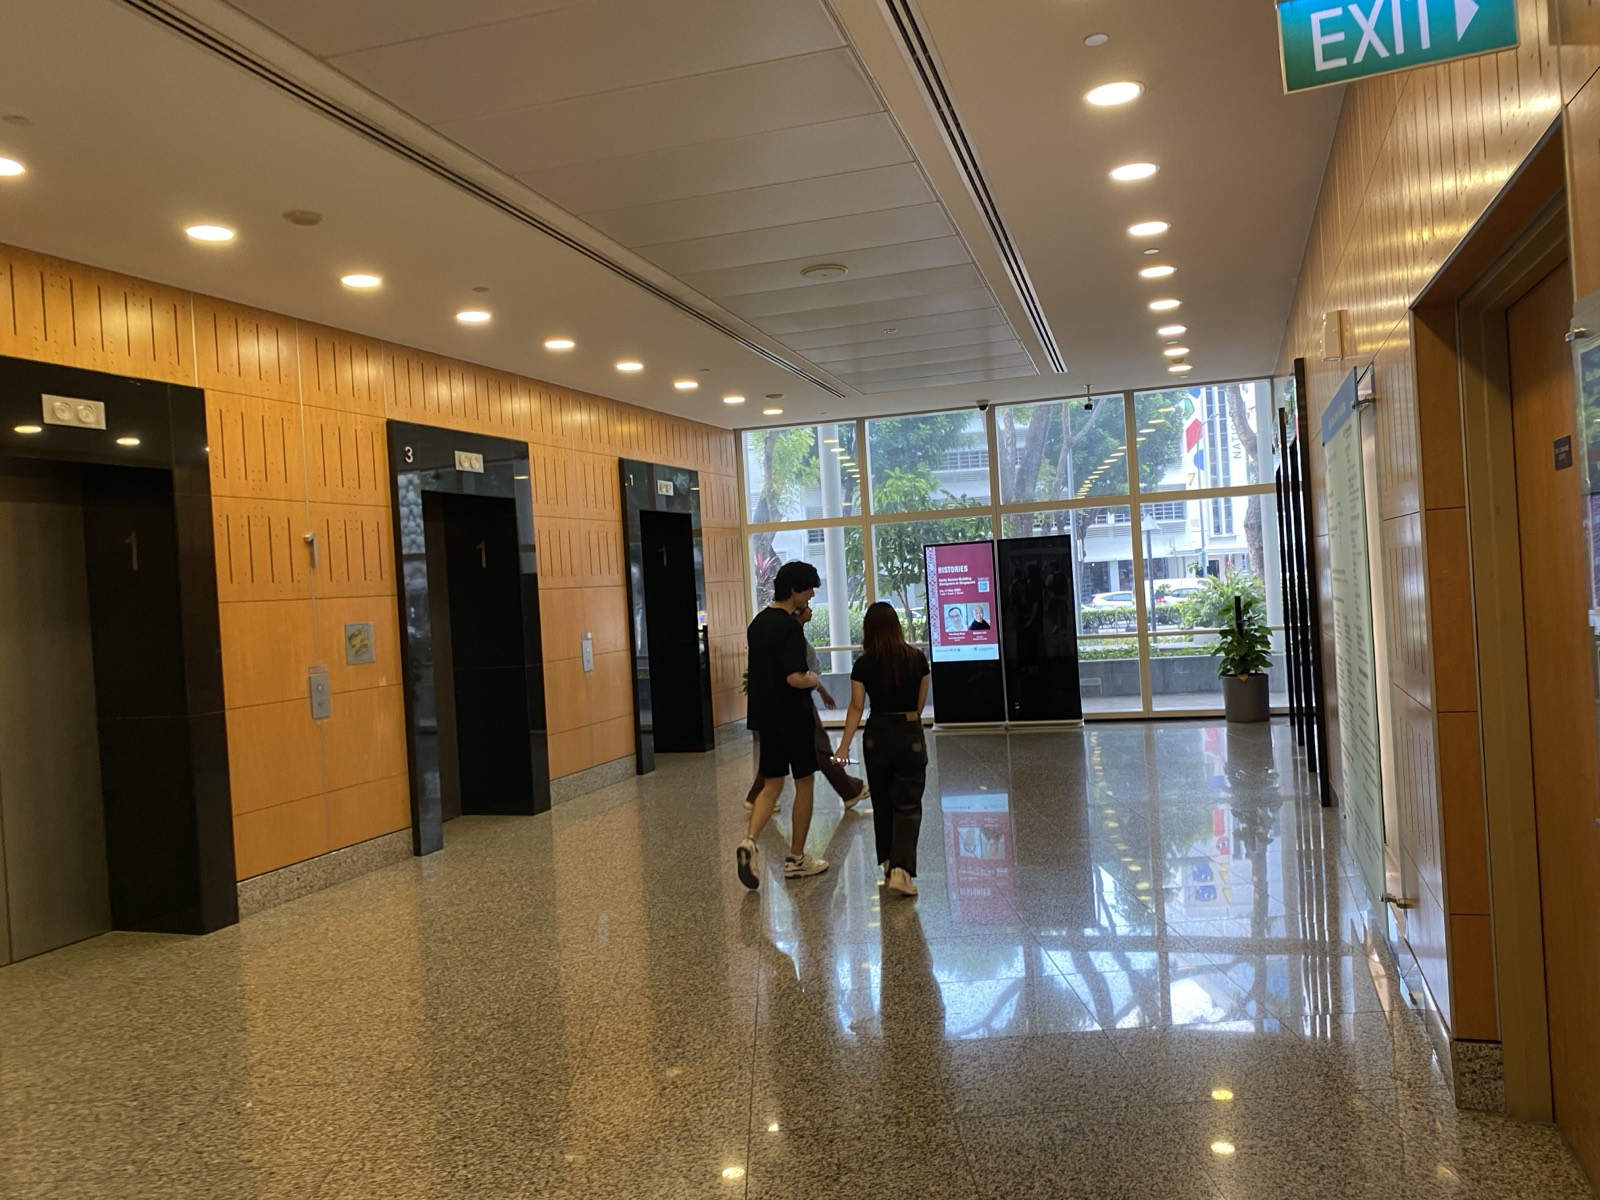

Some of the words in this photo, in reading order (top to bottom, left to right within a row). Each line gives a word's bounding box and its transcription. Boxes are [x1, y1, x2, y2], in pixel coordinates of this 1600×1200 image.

[1310, 0, 1430, 72] EXIT
[404, 446, 414, 463] 3
[124, 530, 138, 571] 1
[475, 539, 487, 568] 1
[658, 544, 667, 567] 1
[938, 566, 968, 574] HISTORIES
